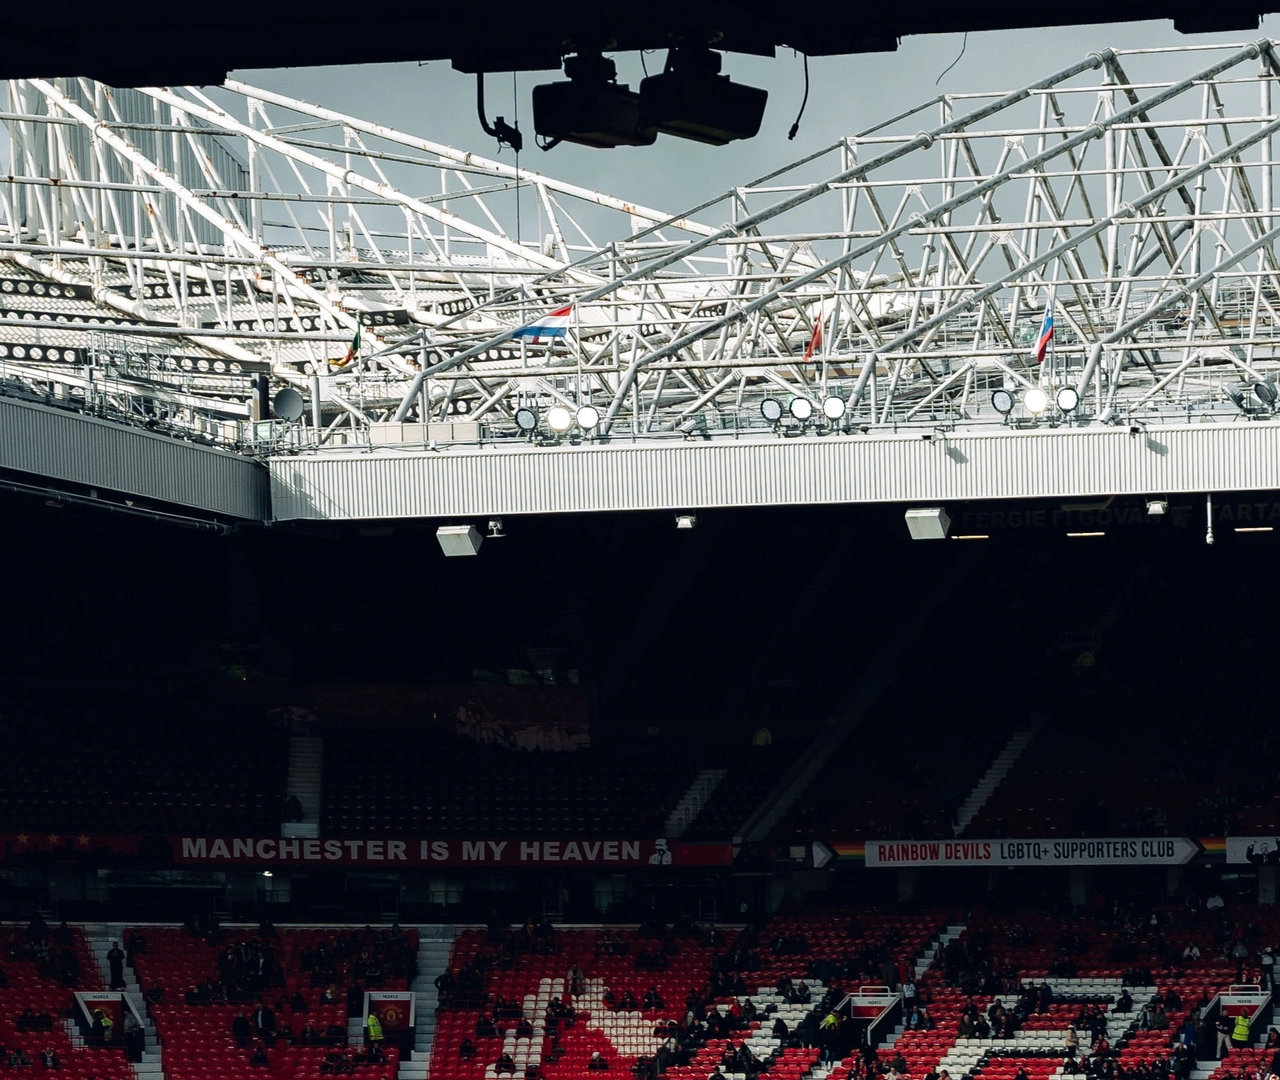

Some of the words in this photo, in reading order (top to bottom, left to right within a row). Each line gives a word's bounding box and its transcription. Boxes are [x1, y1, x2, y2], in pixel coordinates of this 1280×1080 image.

[962, 510, 1046, 529] FERGIE
[181, 838, 407, 861] MANCHESTER
[420, 840, 449, 861] IS
[461, 841, 508, 861] MY
[520, 841, 640, 861] HEAVEN
[878, 843, 940, 862] RAINBOW
[943, 842, 991, 861] DEVILS
[1000, 841, 1050, 861] LGBTQ+
[1053, 840, 1137, 860] SUPPORTERS
[1140, 840, 1174, 859] CLUB
